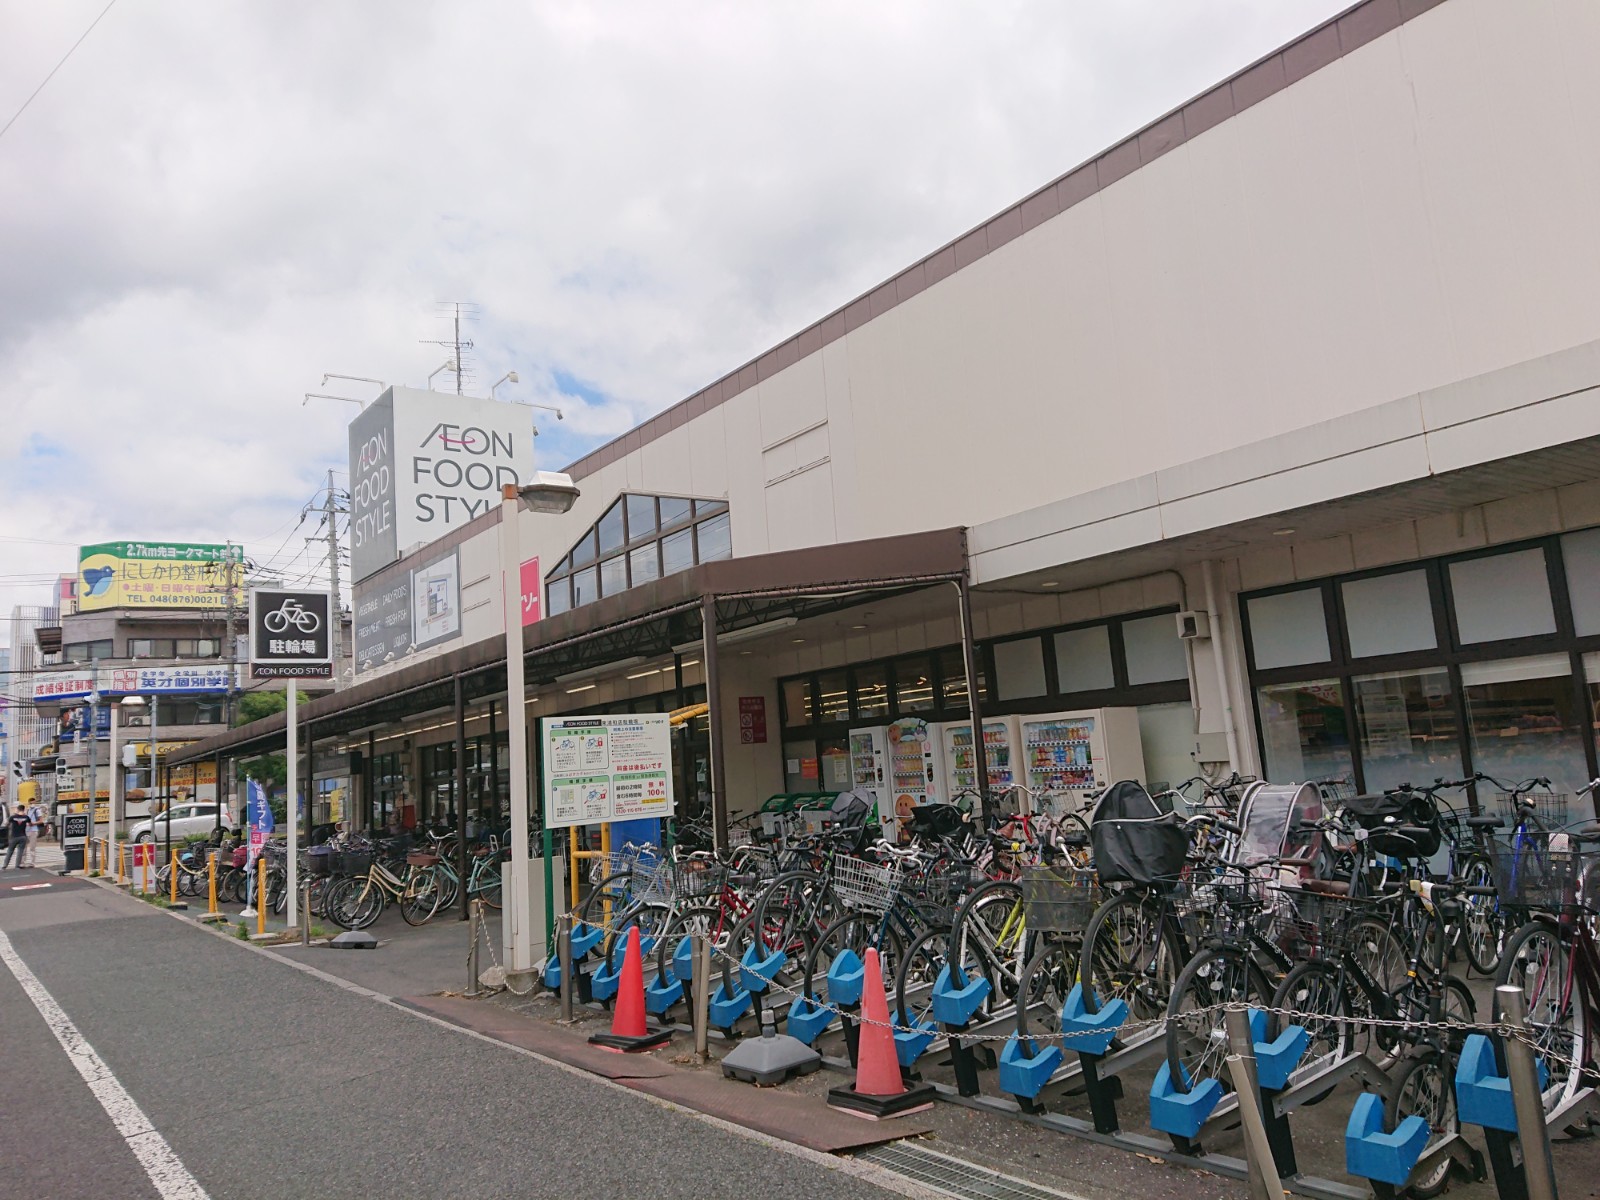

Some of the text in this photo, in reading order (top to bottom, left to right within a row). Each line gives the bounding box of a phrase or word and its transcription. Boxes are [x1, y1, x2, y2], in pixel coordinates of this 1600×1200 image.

[413, 456, 519, 492] FOOD
[354, 464, 390, 513] FOOD
[355, 499, 390, 549] STYLE
[127, 594, 146, 603] TEL
[149, 594, 218, 604] 048(876)0021
[268, 639, 316, 655] 駐輪場
[279, 667, 304, 675] FOOD
[305, 667, 330, 675] STYLE
[616, 762, 662, 771] 料金は後払いです
